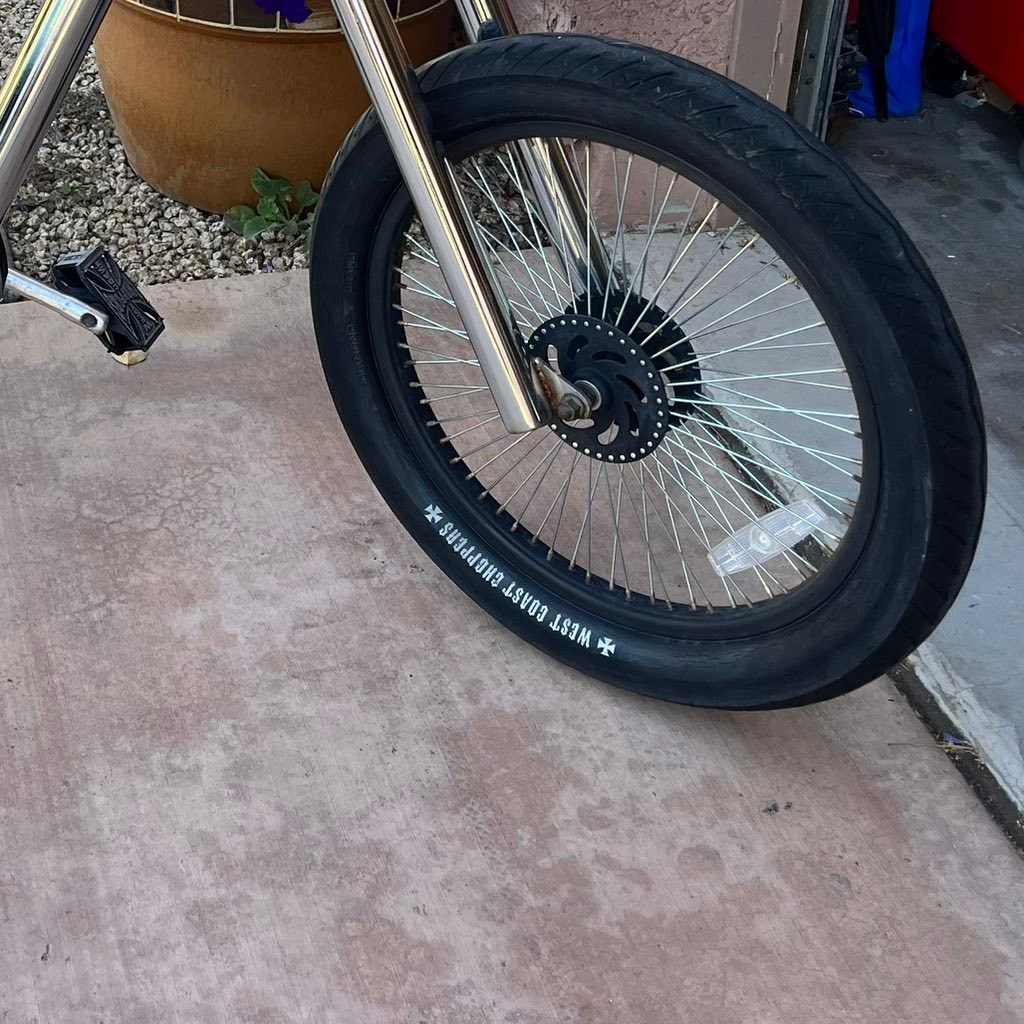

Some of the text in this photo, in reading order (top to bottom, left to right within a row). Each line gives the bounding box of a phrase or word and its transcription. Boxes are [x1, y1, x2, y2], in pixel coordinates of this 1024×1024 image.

[438, 521, 593, 650] WEST COAST CHOPPERS
